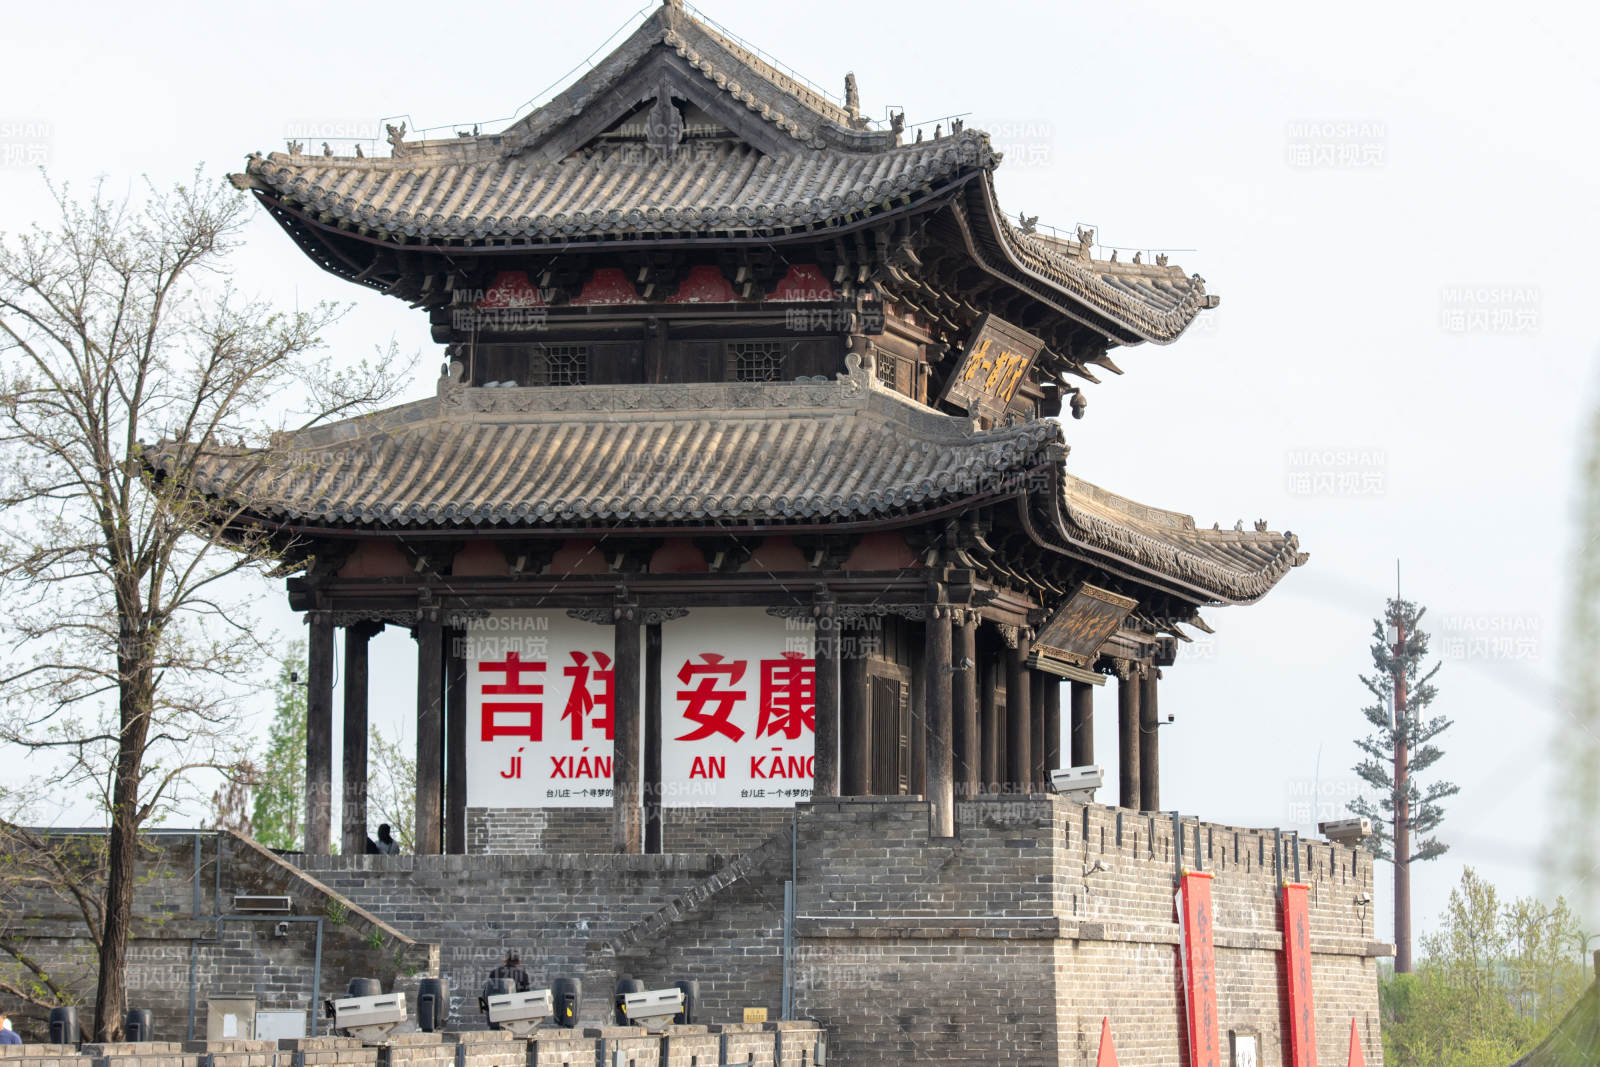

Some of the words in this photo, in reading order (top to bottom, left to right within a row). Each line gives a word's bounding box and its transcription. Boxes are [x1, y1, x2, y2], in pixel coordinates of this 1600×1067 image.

[674, 651, 815, 743] 安康
[550, 746, 614, 779] XIÁN
[689, 756, 726, 779] AN
